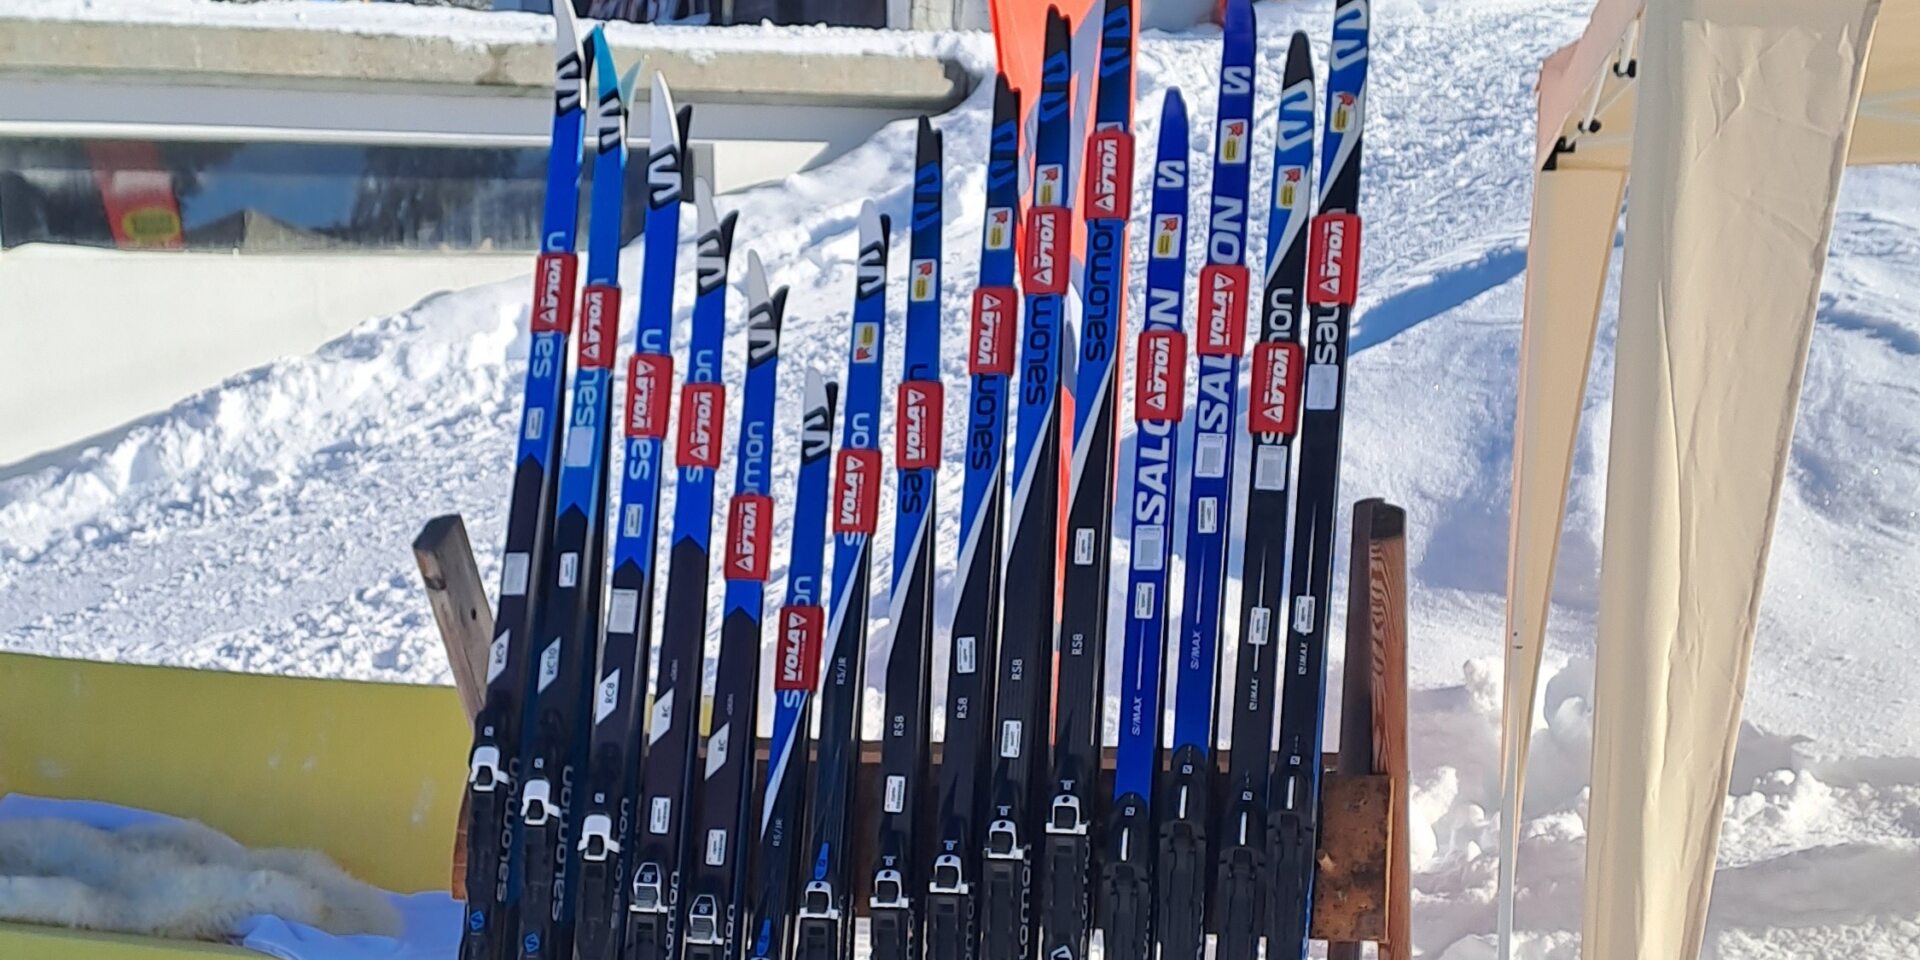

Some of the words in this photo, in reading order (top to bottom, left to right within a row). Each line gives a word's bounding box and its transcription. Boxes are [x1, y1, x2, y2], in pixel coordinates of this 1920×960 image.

[1102, 139, 1118, 194] VOLA
[1039, 214, 1055, 268] VOLA
[1327, 221, 1344, 277] VOLA
[545, 258, 562, 310] VOLA
[587, 292, 603, 344] VOLA
[978, 312, 994, 365] VOLA
[1209, 291, 1227, 346] VOLA
[1026, 297, 1051, 406] salom
[1152, 338, 1169, 392] VOLA
[1271, 349, 1289, 403] VOLA
[632, 374, 650, 428] VOLA
[695, 392, 712, 443] VOLA
[906, 406, 921, 459] VOLA
[841, 472, 858, 525] VOLA
[741, 503, 756, 554] VOLA
[495, 643, 505, 664] RC9
[784, 630, 802, 681] VOLA
[1012, 659, 1023, 680] RS8
[1072, 634, 1083, 655] RS8
[1191, 630, 1202, 670] S/MAX
[604, 683, 615, 704] RC8
[956, 697, 968, 719] RS8
[1132, 697, 1143, 736] S/MAX
[894, 715, 904, 737] RS8
